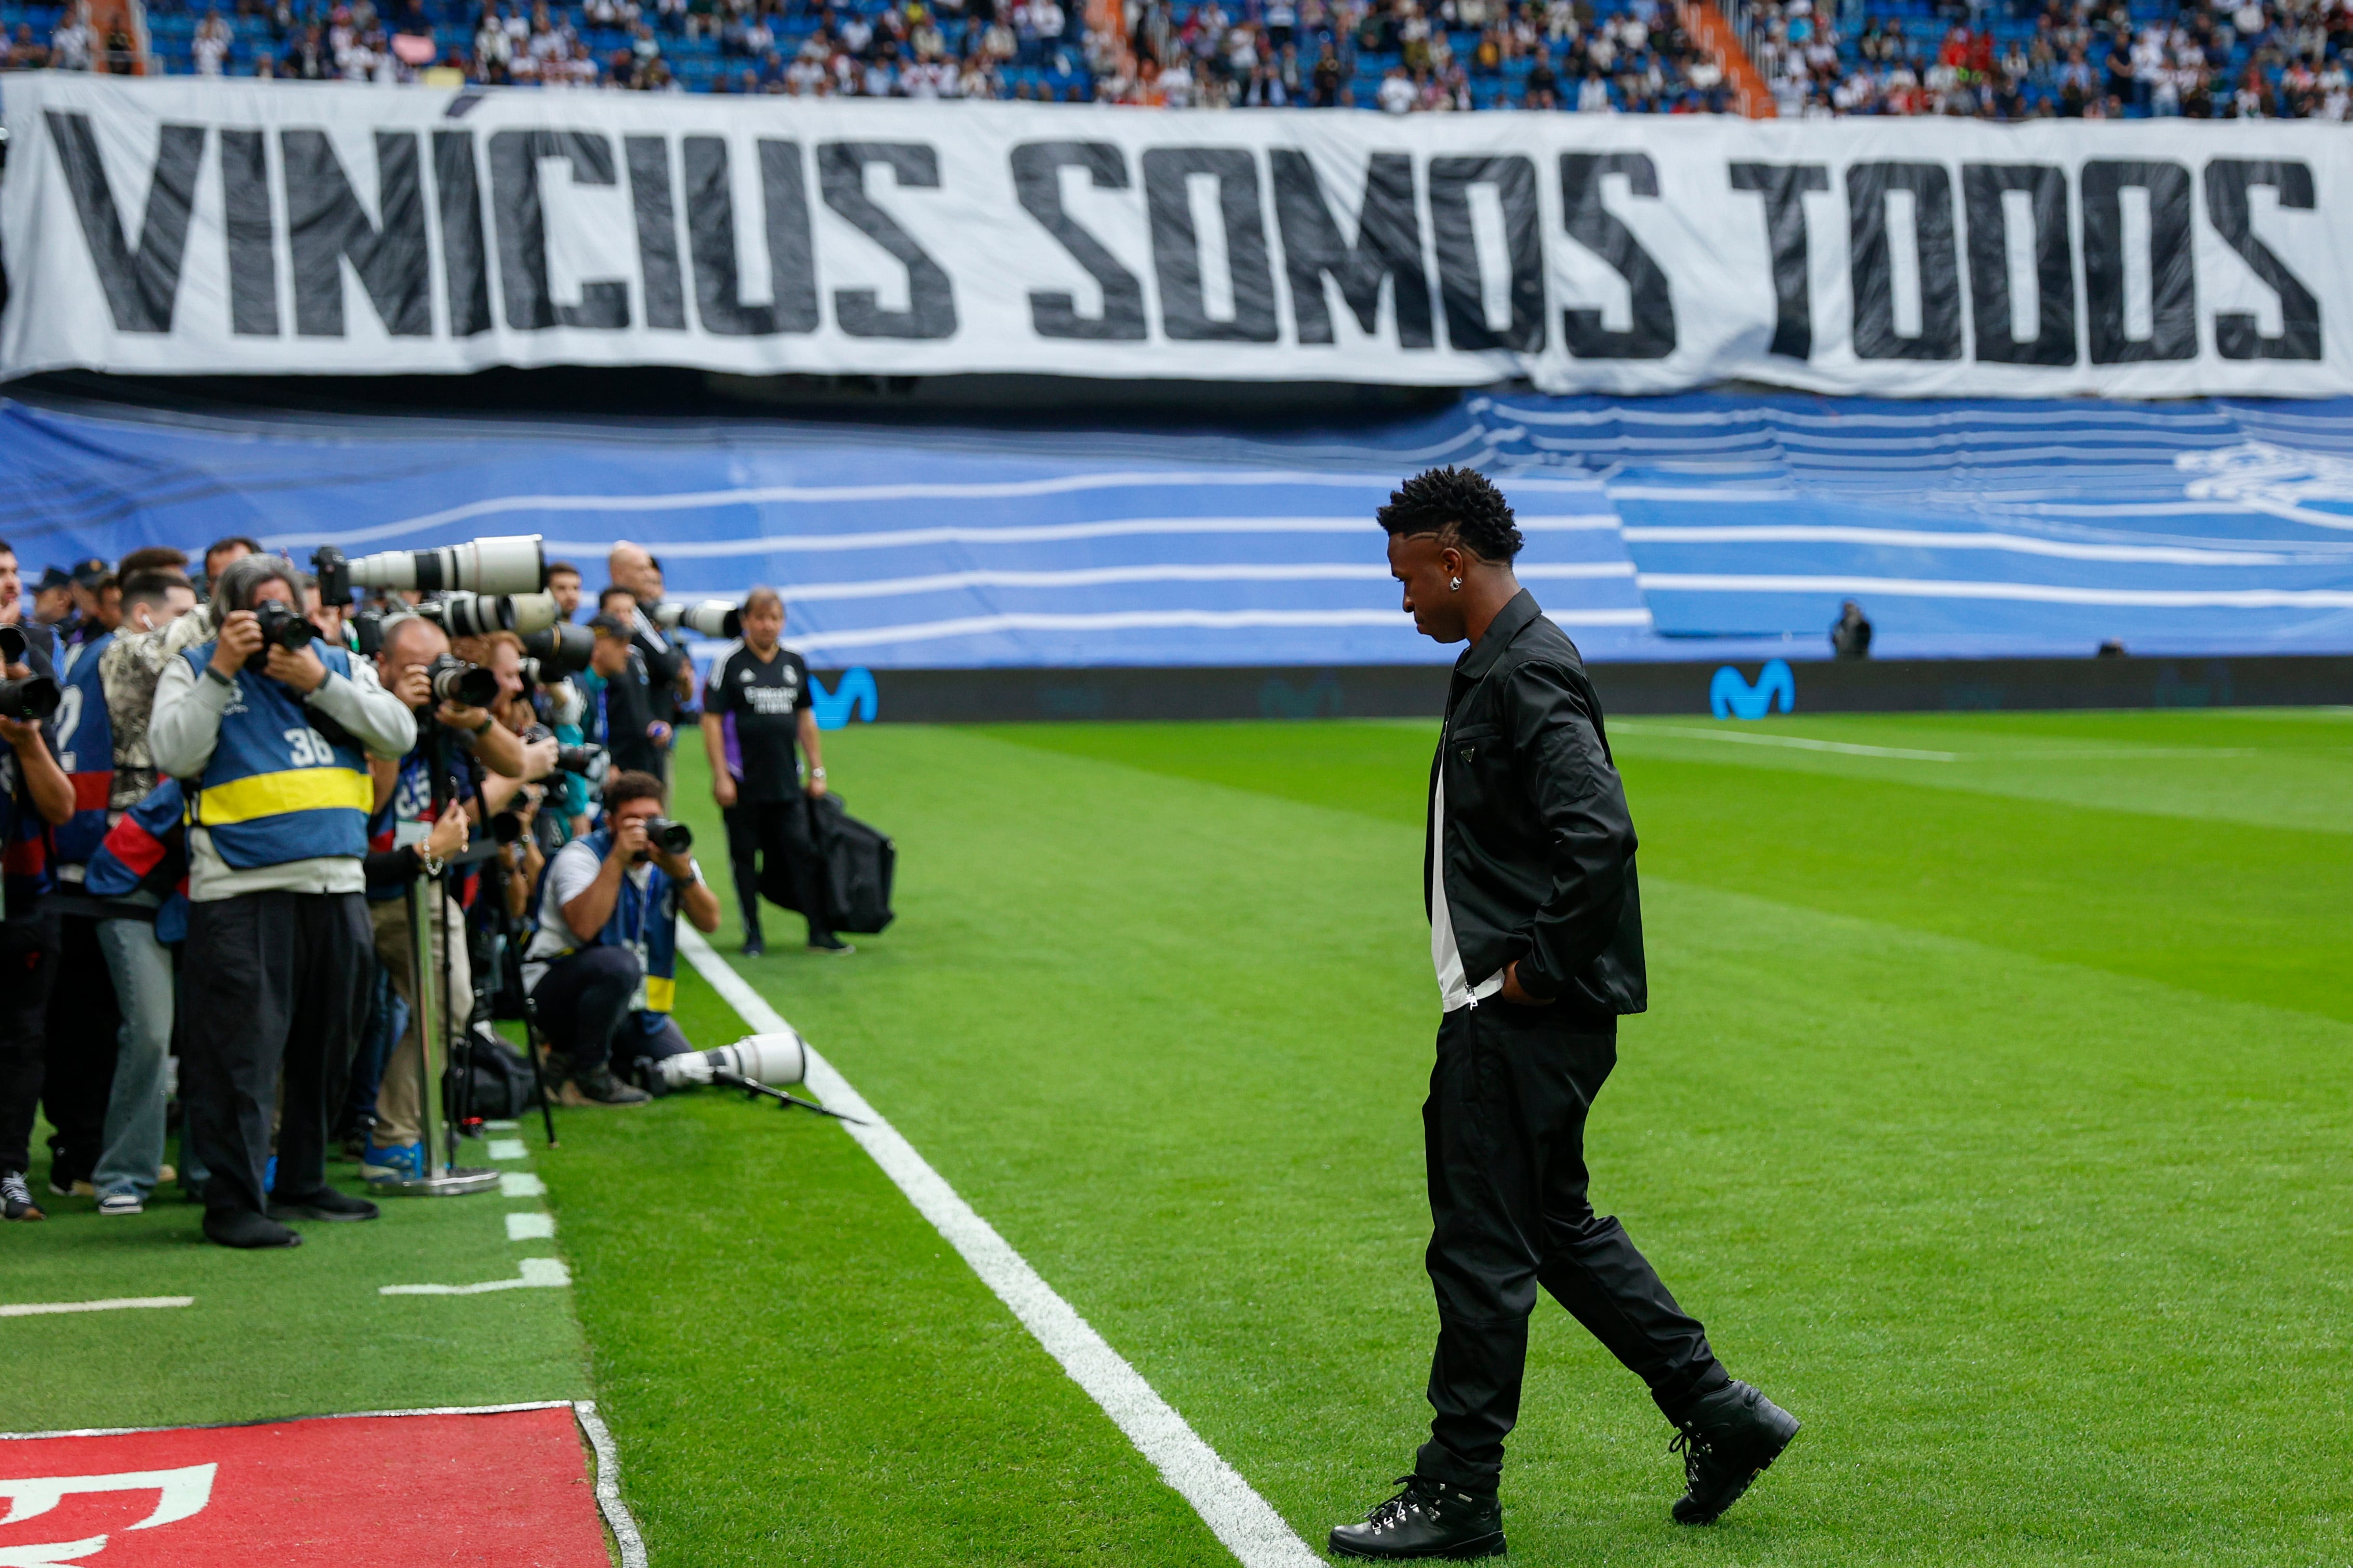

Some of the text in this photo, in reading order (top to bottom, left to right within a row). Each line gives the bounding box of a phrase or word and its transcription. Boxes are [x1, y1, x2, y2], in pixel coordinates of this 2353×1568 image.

[44, 96, 2323, 367] VINÍCIUS SOMOS TODOS
[283, 726, 336, 767] 36
